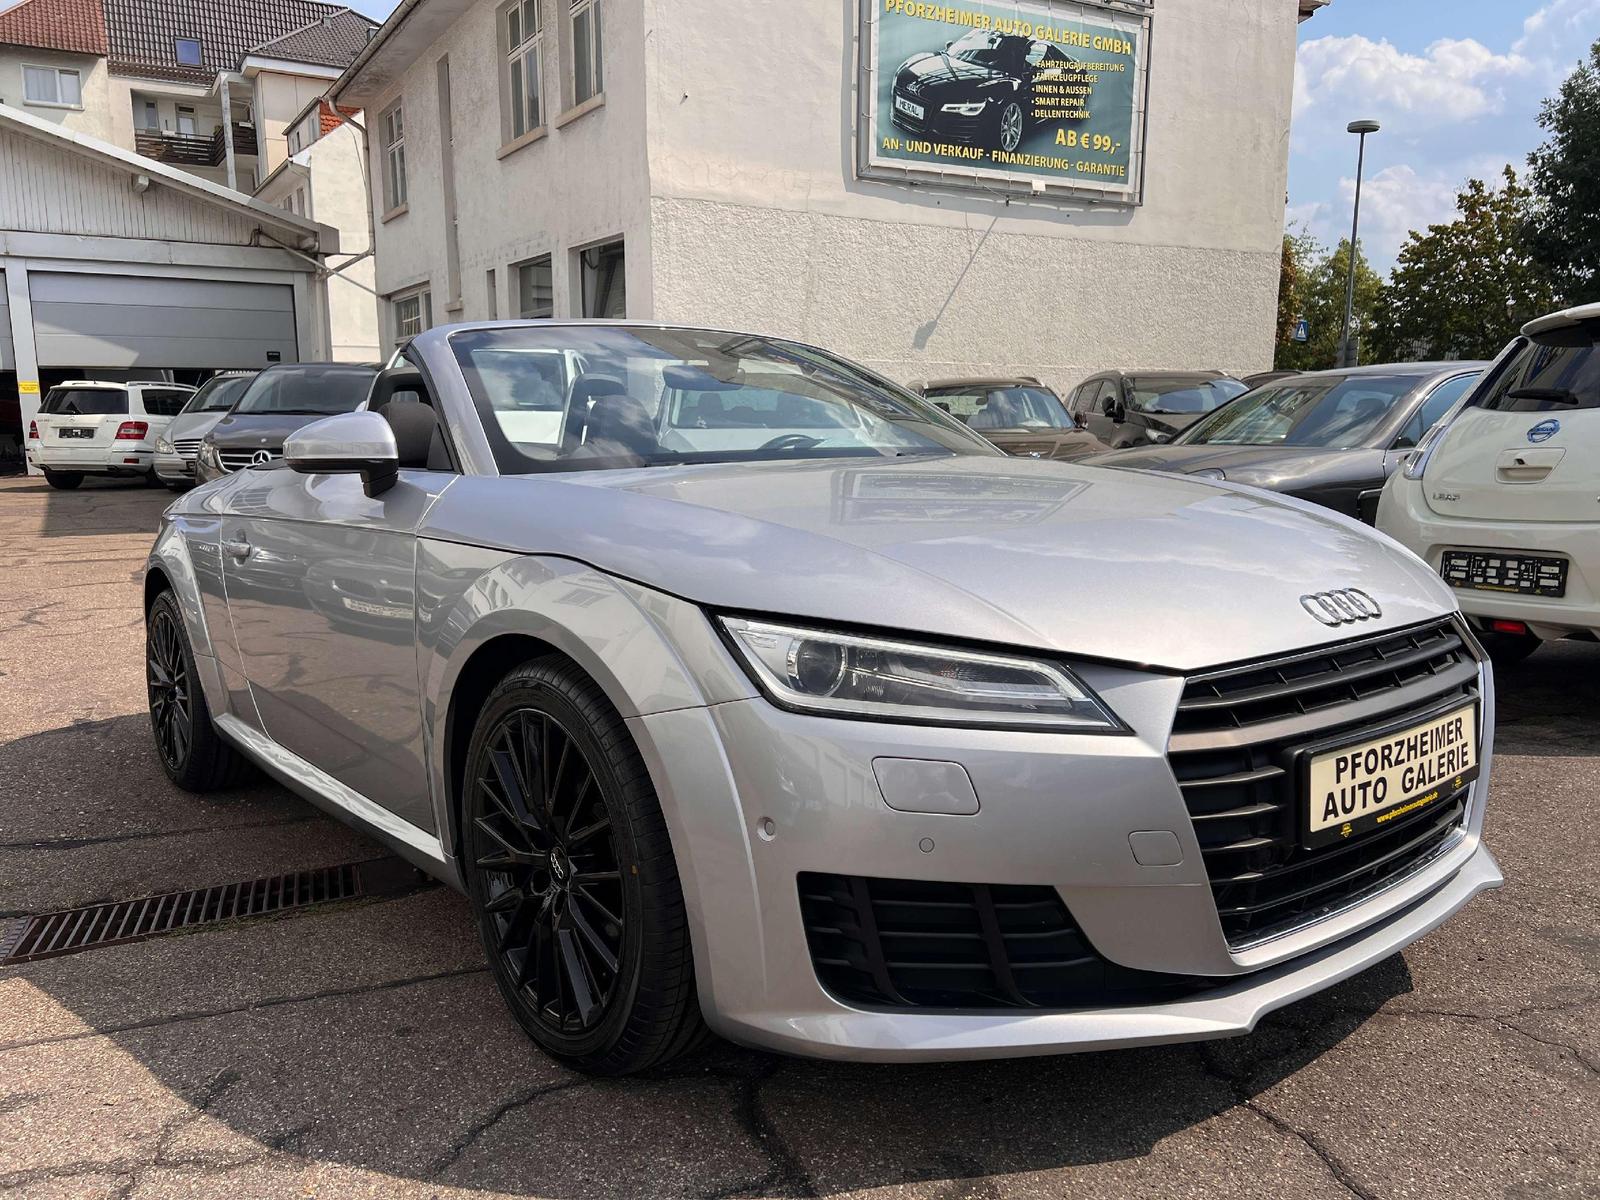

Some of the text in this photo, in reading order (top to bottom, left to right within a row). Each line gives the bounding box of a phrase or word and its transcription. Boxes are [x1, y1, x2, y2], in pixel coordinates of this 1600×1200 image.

[885, 0, 1131, 55] PFORZHEIMER AUTO GALERIE GMBH
[1036, 60, 1125, 72] FAHRZEUGAUFBEREITUNG
[1036, 72, 1098, 83] FAHRZEUGPFLEGE
[1035, 85, 1092, 95] INNEN & AUSSEN
[1035, 97, 1085, 107] SMART REPAIR
[1034, 109, 1091, 119] DELLENTECHNIK
[1055, 128, 1121, 154] AB € 99,-
[882, 137, 904, 150] AN-
[906, 140, 931, 154] UND
[933, 143, 984, 160] VERKAUF
[992, 150, 1069, 170] FINANZIERUNG
[1076, 161, 1125, 177] GARANTIE
[1335, 717, 1463, 784] PFORZHEIMER
[1322, 777, 1387, 822] AUTO
[1401, 742, 1469, 794] GALERIE
